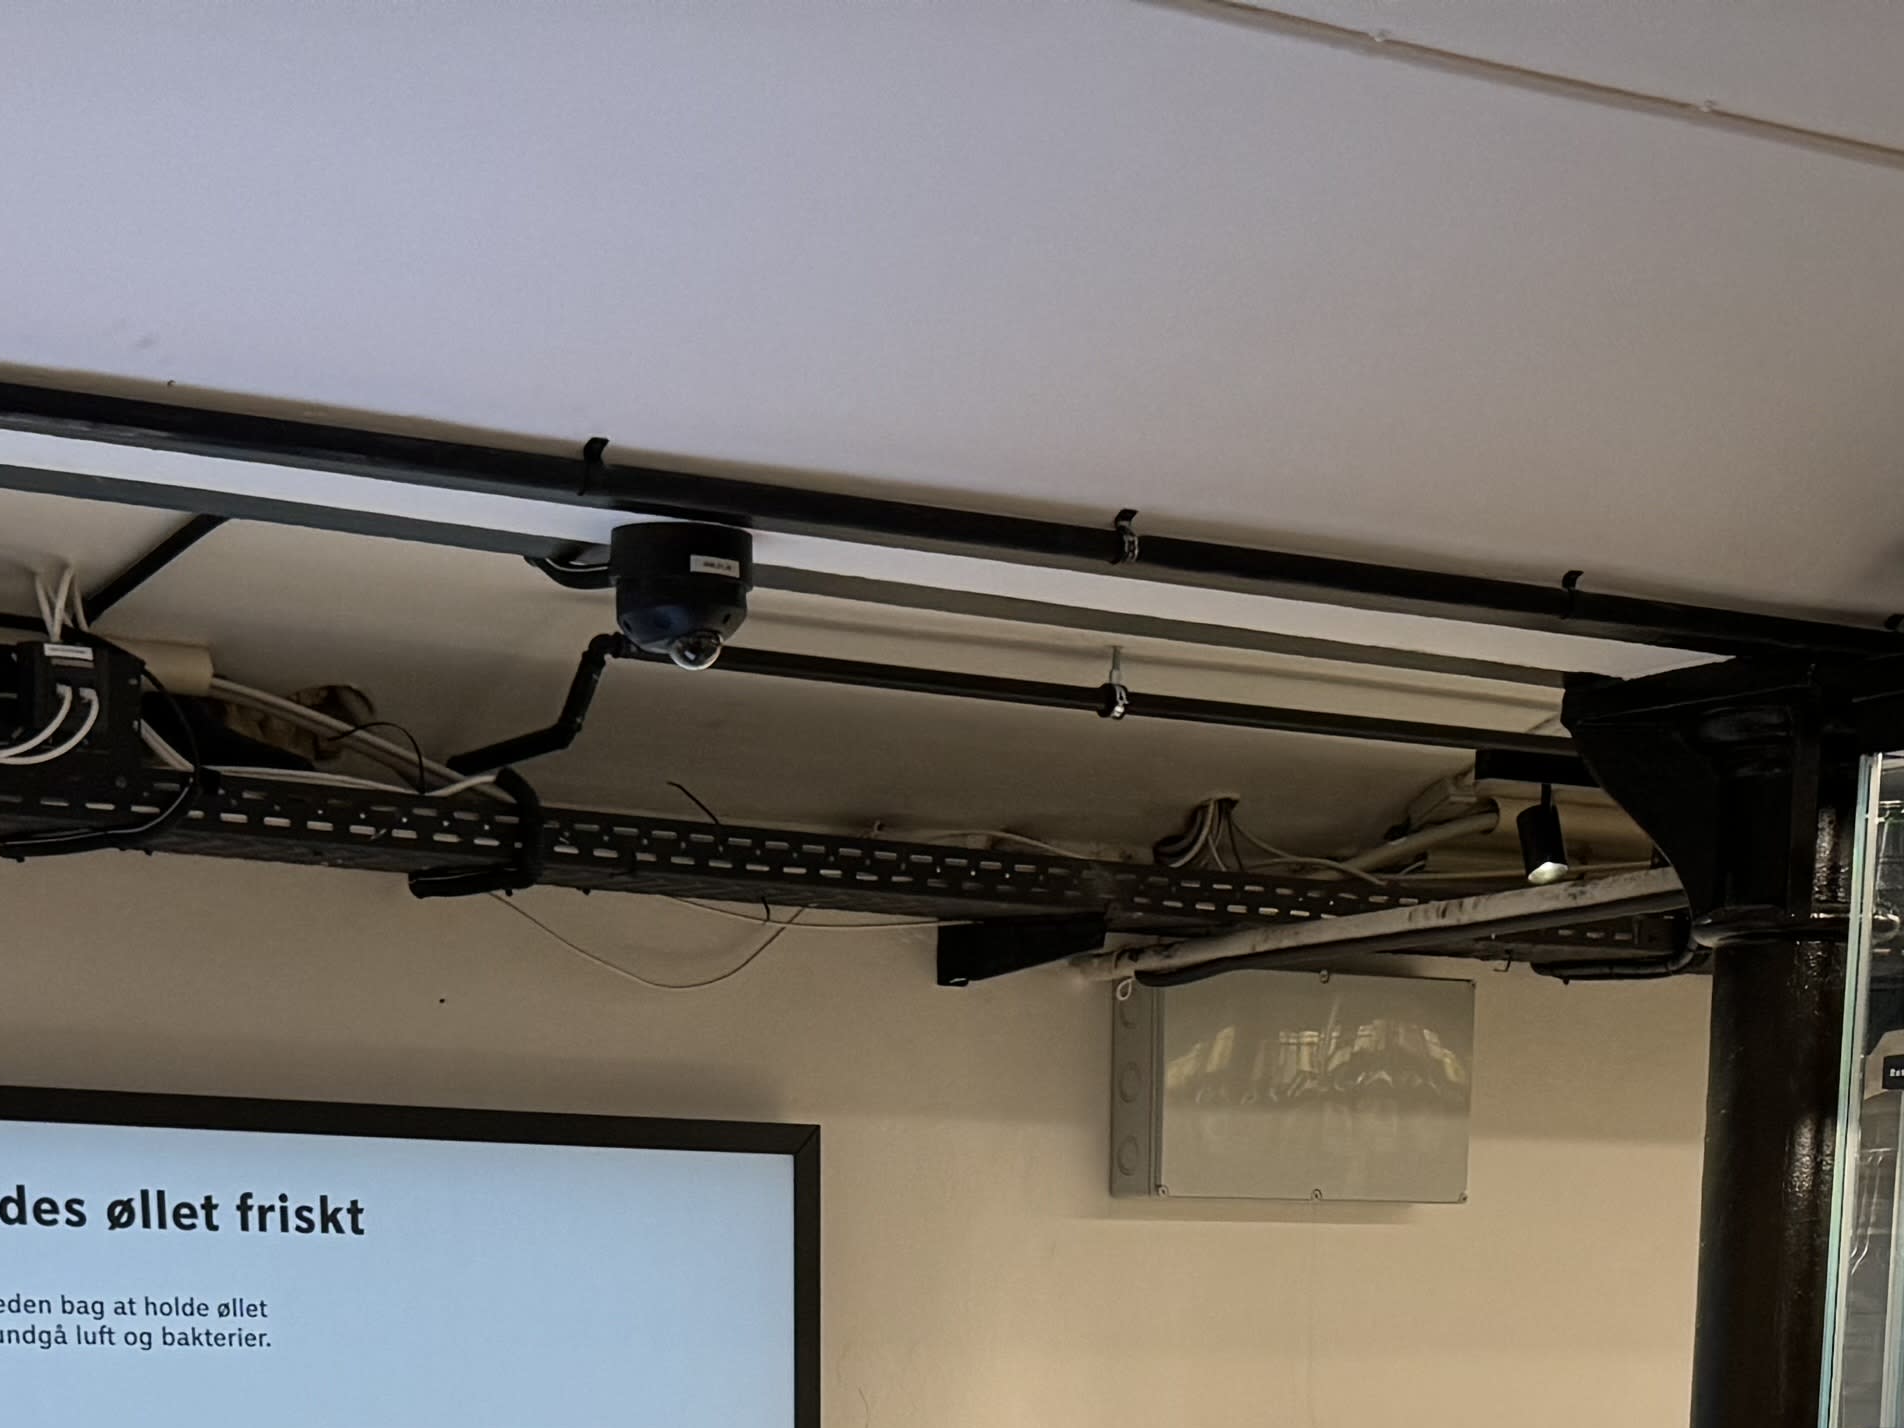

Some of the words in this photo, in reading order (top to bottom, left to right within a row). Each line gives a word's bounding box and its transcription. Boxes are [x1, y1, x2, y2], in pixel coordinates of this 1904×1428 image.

[106, 1188, 220, 1232] øllet
[235, 1191, 365, 1236] friskt
[60, 1294, 105, 1321] bag
[113, 1297, 137, 1316] at
[144, 1295, 210, 1318] holde
[217, 1297, 268, 1318] øllet
[76, 1324, 116, 1346] luft
[123, 1331, 153, 1352] og
[161, 1325, 272, 1348] bakterier.
